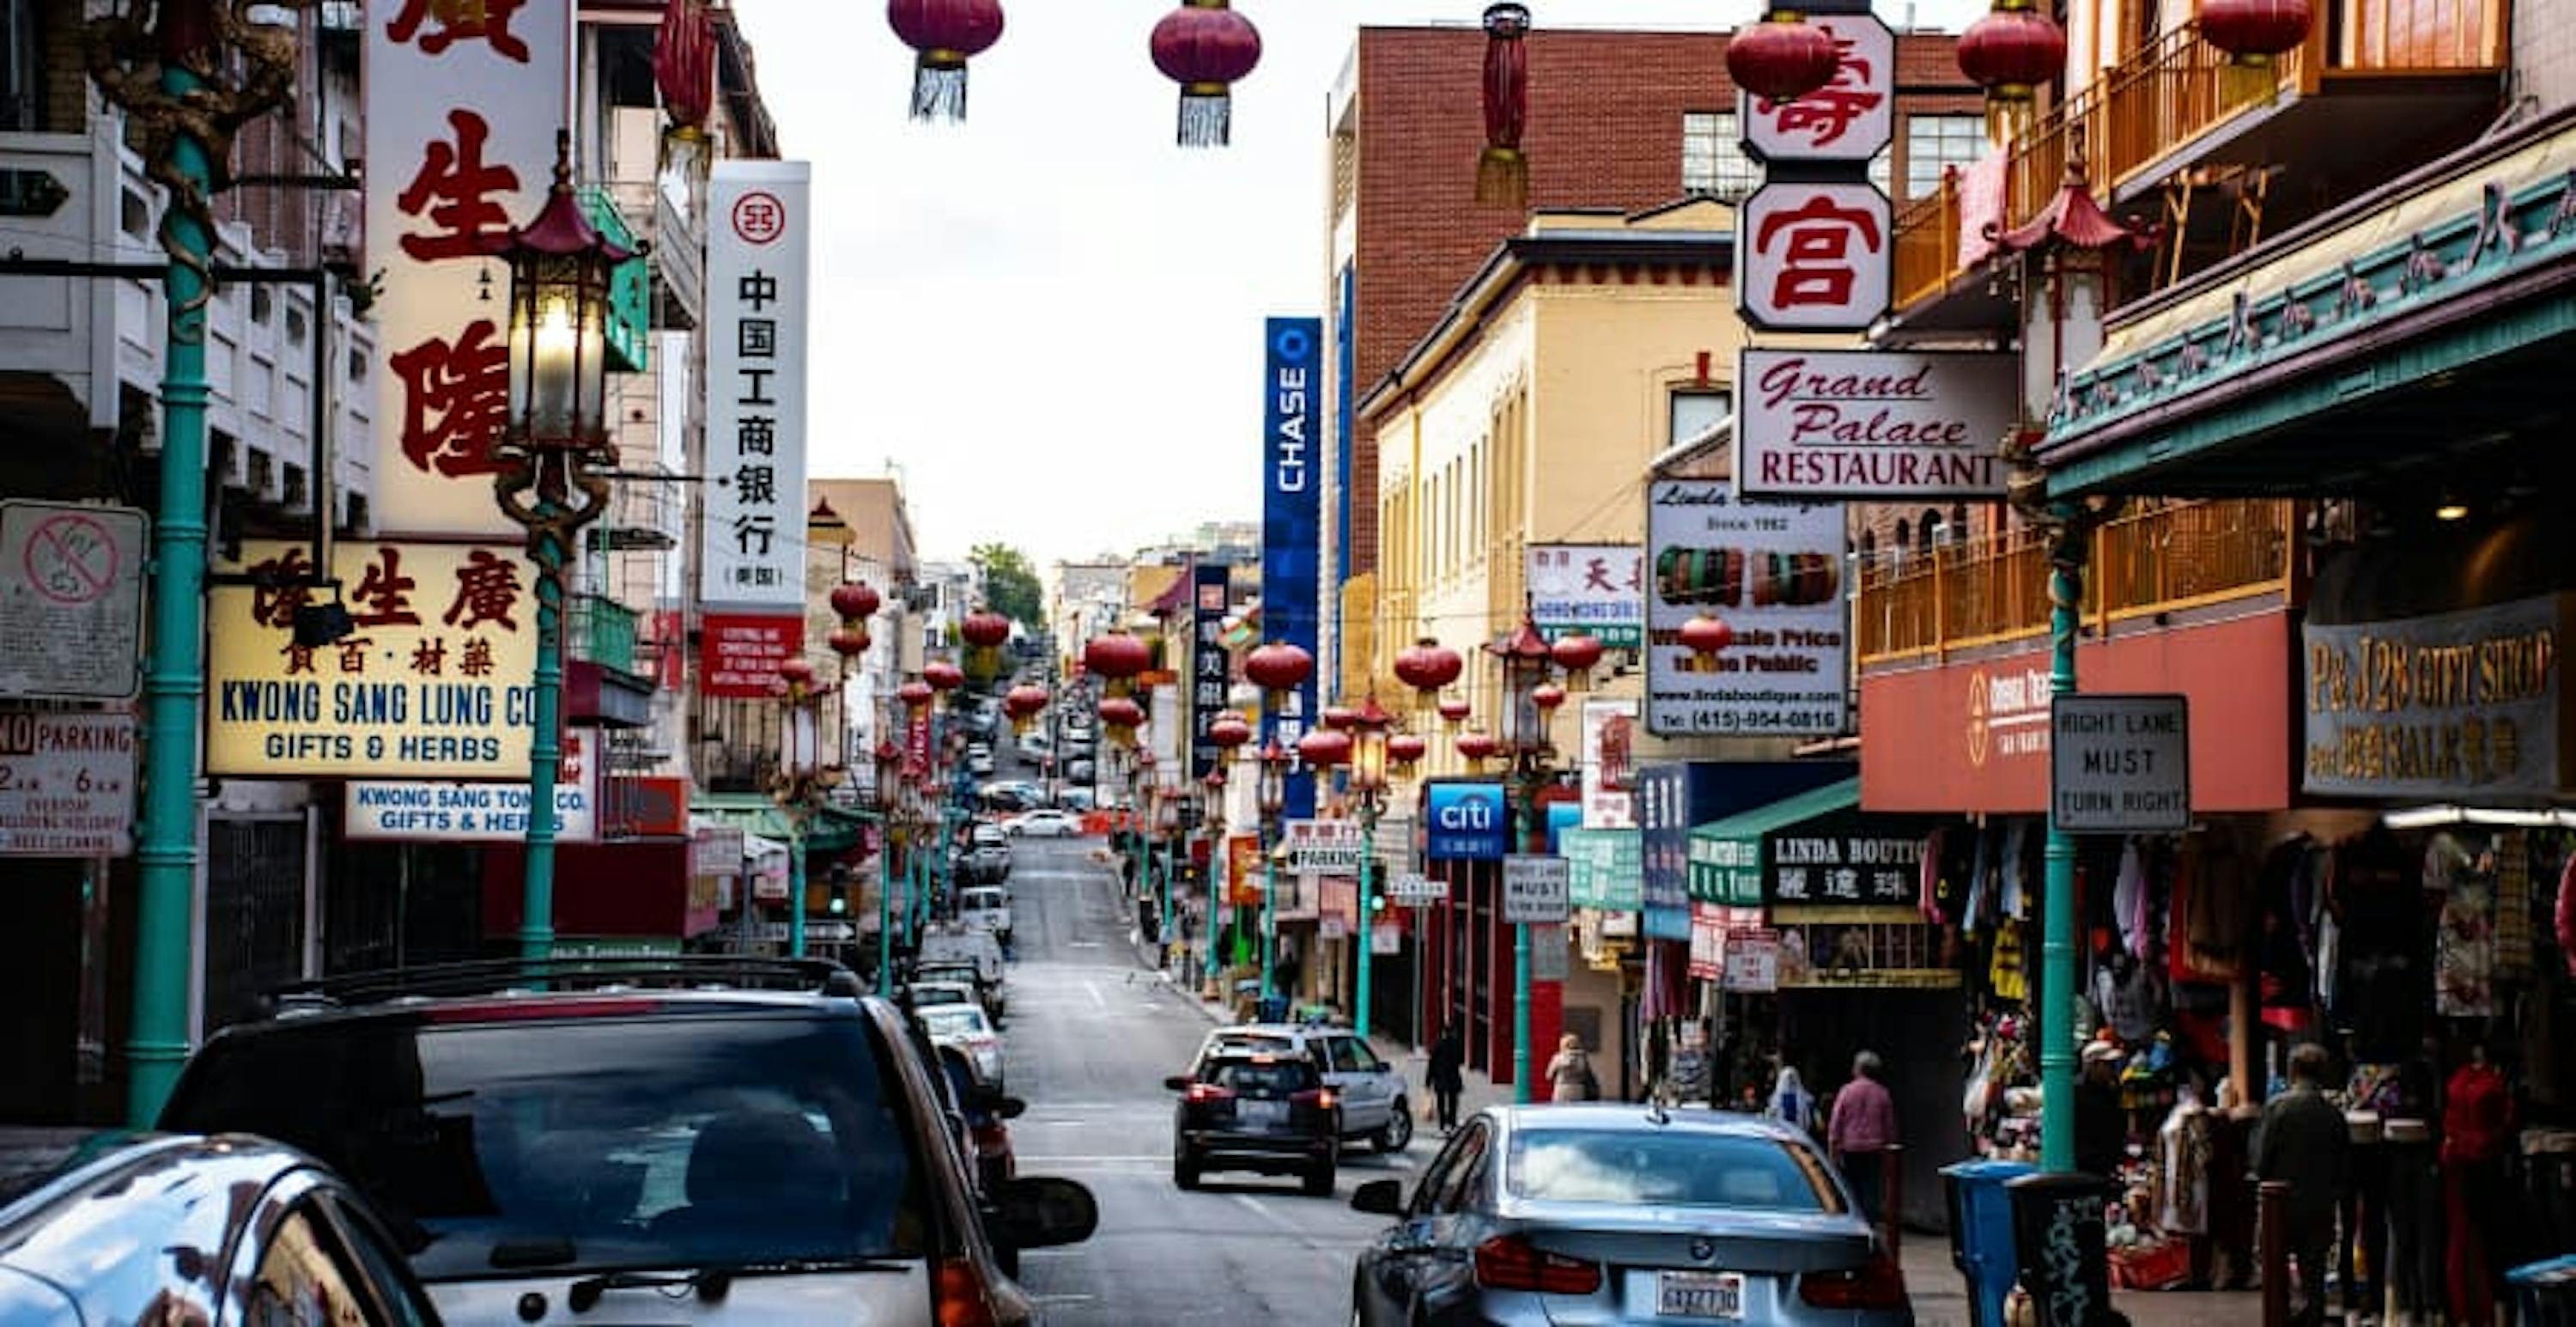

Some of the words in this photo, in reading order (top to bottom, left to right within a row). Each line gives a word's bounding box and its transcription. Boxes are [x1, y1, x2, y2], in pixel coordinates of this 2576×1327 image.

[1760, 358, 1932, 410] Grand
[735, 269, 776, 554] 中国工商银行
[1790, 404, 1967, 442] Palace
[1279, 367, 1306, 492] CHASE
[1762, 452, 1996, 486] RESTAURANT
[1779, 629, 1840, 647] Price
[1746, 654, 1818, 673] Public
[2416, 646, 2474, 708] GIFT
[222, 680, 321, 722] KWONG
[334, 681, 408, 724] SANG
[421, 683, 493, 727] LUNG
[39, 723, 130, 752] PARKING
[2063, 713, 2115, 733] RIGHT
[2125, 714, 2179, 733] LANE
[266, 734, 353, 760] GIFTS
[366, 735, 385, 760] &
[399, 736, 501, 763] HERBS
[2084, 749, 2154, 775] MUST
[358, 787, 432, 807] KWONG
[438, 788, 490, 808] SANG
[499, 789, 532, 809] TON
[2063, 791, 2112, 812] TURN
[2123, 790, 2182, 812] RIGHT
[381, 810, 451, 831] GIFTS
[460, 812, 476, 831] &
[485, 812, 565, 832] HERS
[1440, 800, 1491, 831] citi
[1775, 837, 1841, 865] LINDA
[1511, 882, 1560, 896] MUST
